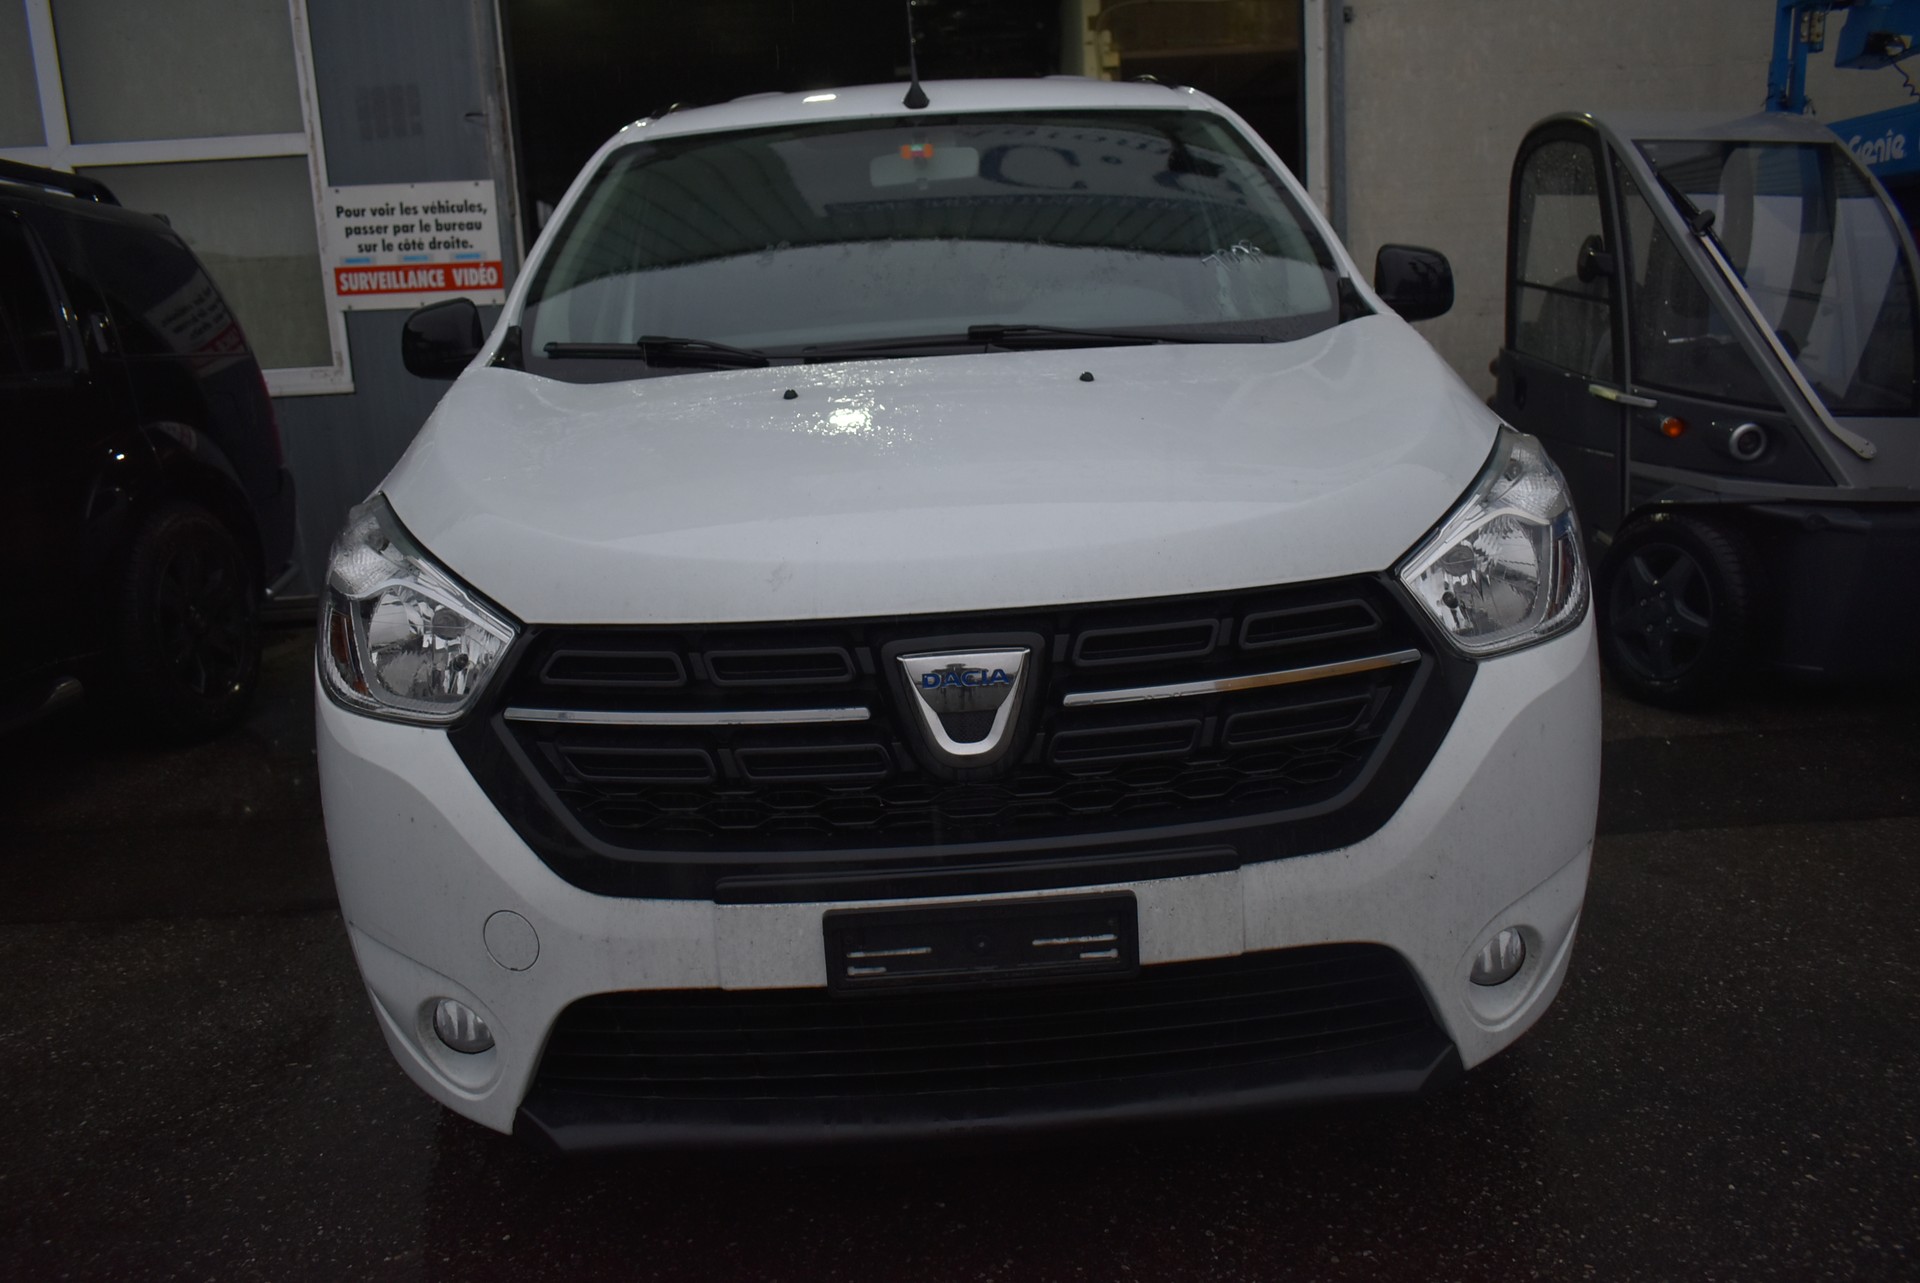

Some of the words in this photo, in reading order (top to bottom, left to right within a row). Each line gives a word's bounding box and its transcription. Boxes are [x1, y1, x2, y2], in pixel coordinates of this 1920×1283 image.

[1848, 129, 1906, 165] Genie
[336, 205, 365, 218] Pour
[371, 203, 396, 217] voir
[400, 201, 418, 216] les
[422, 200, 487, 216] véhicules,
[345, 223, 388, 238] passer
[393, 222, 415, 237] par
[419, 219, 431, 233] le
[435, 219, 482, 232] bureau
[358, 241, 378, 253] sur
[382, 239, 393, 252] le
[398, 237, 424, 251] côté
[429, 237, 473, 250] droite.
[338, 269, 446, 292] SURVEILLANCE
[451, 263, 498, 288] VIDÉO
[922, 669, 1009, 689] DACIA
